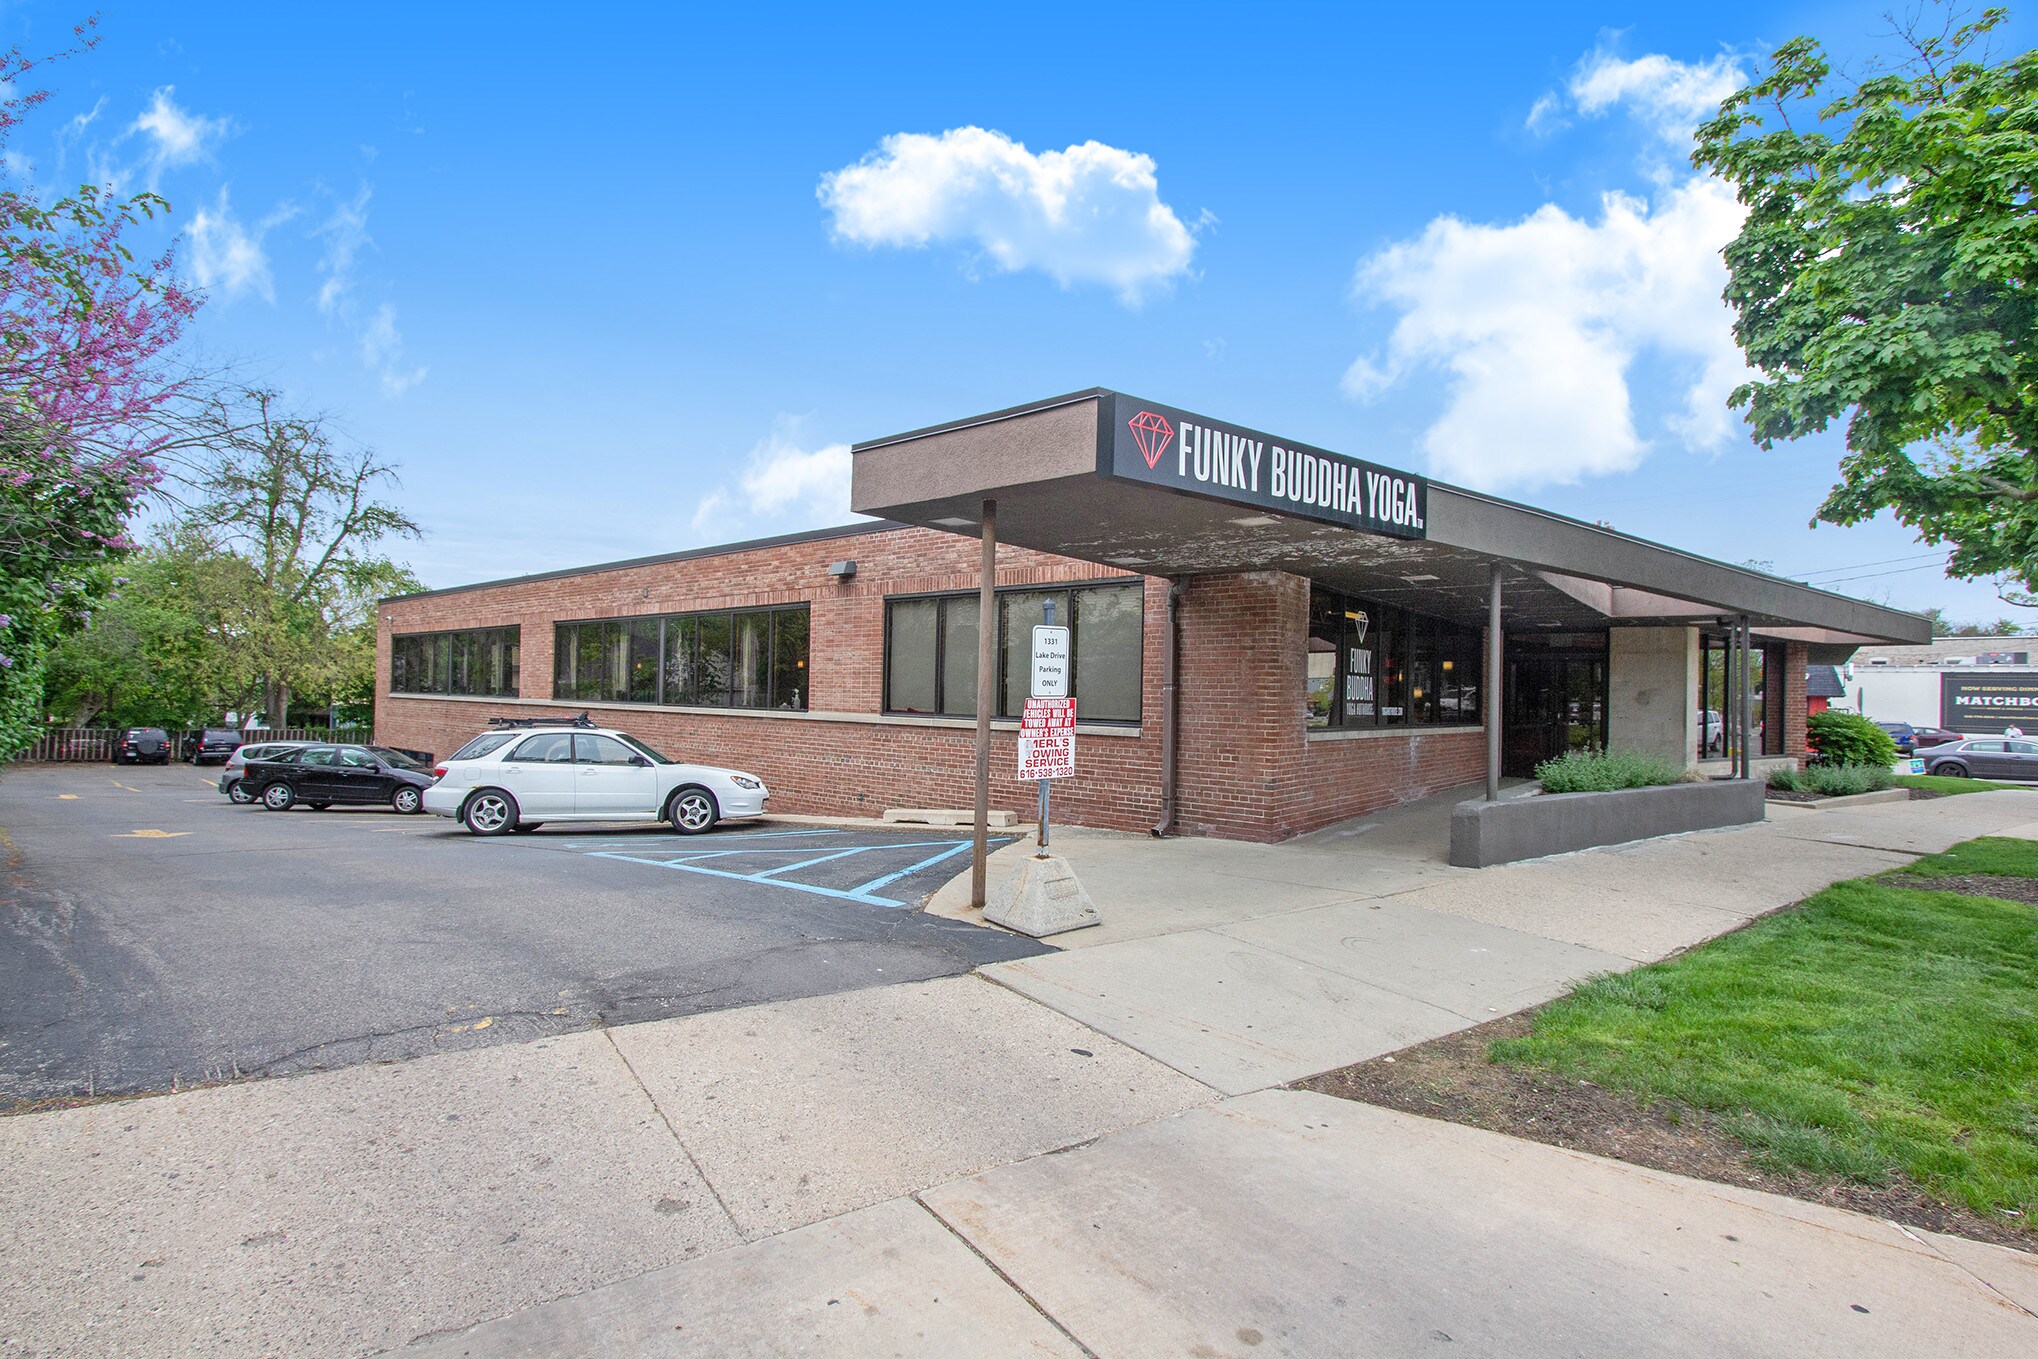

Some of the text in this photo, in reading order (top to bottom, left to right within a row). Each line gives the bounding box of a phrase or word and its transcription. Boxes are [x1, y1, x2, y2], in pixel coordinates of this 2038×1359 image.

[1178, 421, 1424, 529] FUNKY BUDDHA YOGA.
[1050, 652, 1066, 660] Drive
[1350, 648, 1371, 674] FUNKY
[1039, 666, 1061, 675] Parking
[1347, 675, 1373, 700] BUDDHA
[1027, 699, 1070, 709] UNAUTHORIZED
[1052, 709, 1065, 718] WILL
[1066, 708, 1074, 718] BE
[1024, 717, 1072, 728] TOWED AWAY AT
[1020, 727, 1074, 738] OWNER'S EXPENSE
[1026, 748, 1070, 759] OWING
[1025, 757, 1069, 768] SERVICE
